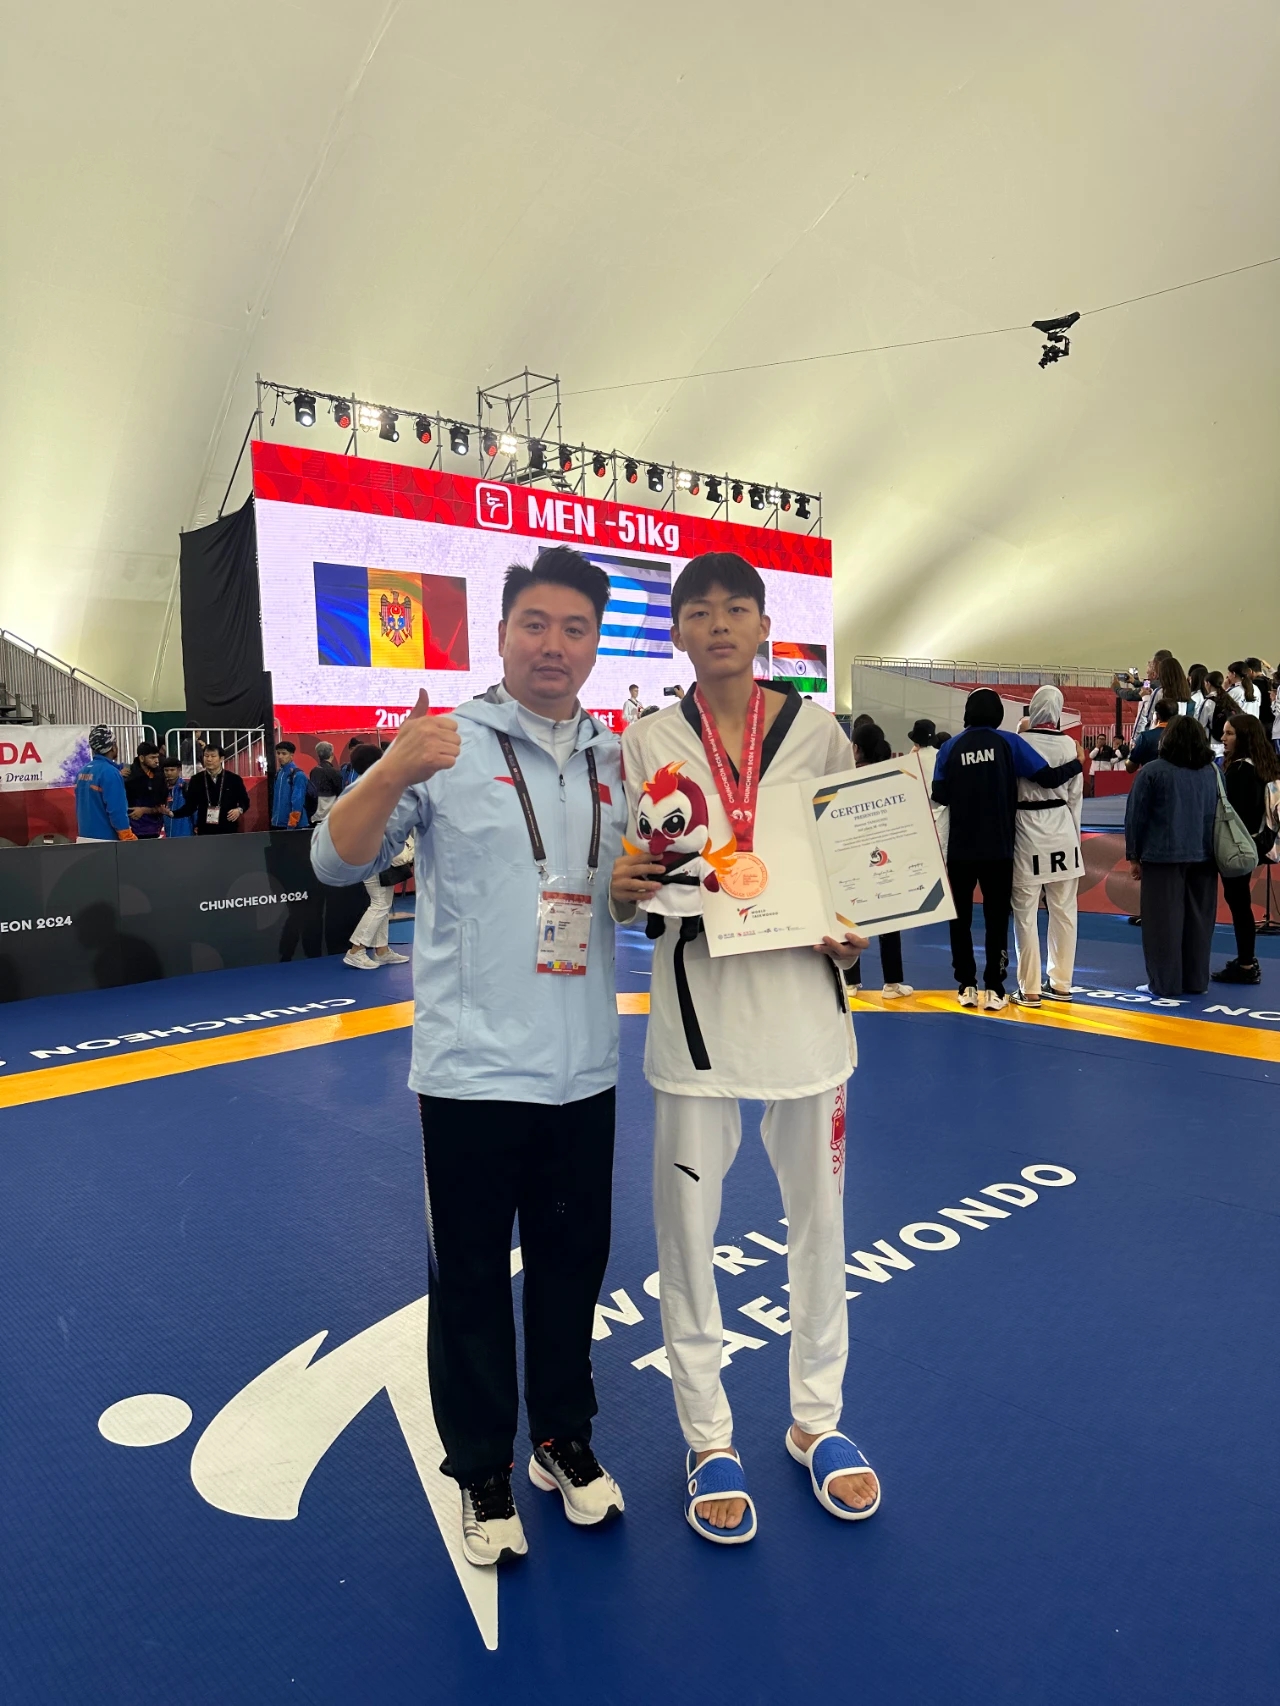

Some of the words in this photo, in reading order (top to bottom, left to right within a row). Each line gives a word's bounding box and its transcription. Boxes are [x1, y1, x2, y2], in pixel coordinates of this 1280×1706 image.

[527, 495, 596, 538] MEN
[605, 510, 680, 552] -51kg
[375, 708, 412, 728] 2nd
[0, 741, 42, 765] DA
[961, 748, 995, 766] IRAN
[5, 771, 43, 782] Dream!
[743, 767, 753, 804] CHUNCHEON
[830, 793, 906, 819] CERTIFICATE
[854, 811, 880, 821] PRESENTED
[1032, 847, 1079, 875] IRI
[199, 894, 277, 911] CHUNCHEON
[280, 891, 308, 903] 2024
[0, 919, 32, 933] EON
[36, 915, 73, 930] 2024
[29, 998, 356, 1060] CHUNCHEON
[591, 1217, 790, 1341] WRL
[630, 1164, 1077, 1380] TAEWONDO
